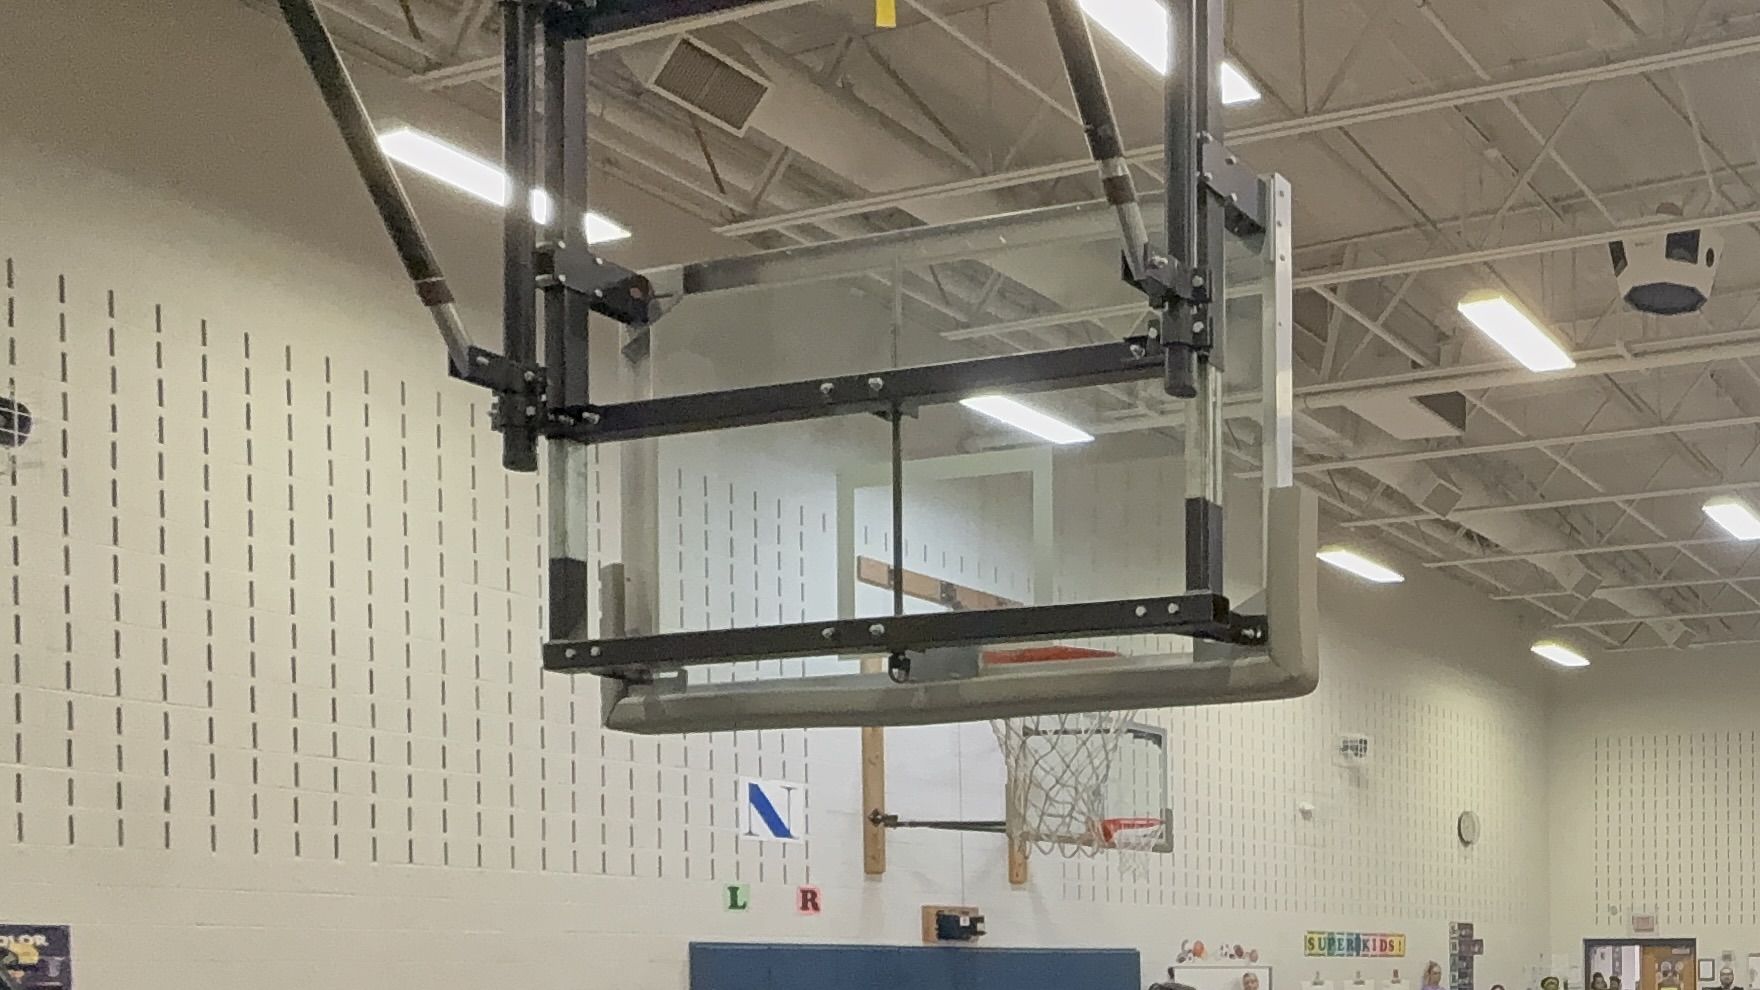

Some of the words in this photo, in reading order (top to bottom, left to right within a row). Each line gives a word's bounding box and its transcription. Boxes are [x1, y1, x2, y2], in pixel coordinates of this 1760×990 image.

[743, 782, 800, 839] N
[727, 886, 747, 910] L
[800, 889, 821, 912] R
[1307, 937, 1356, 952] SUPER
[1361, 937, 1402, 953] KIDS!
